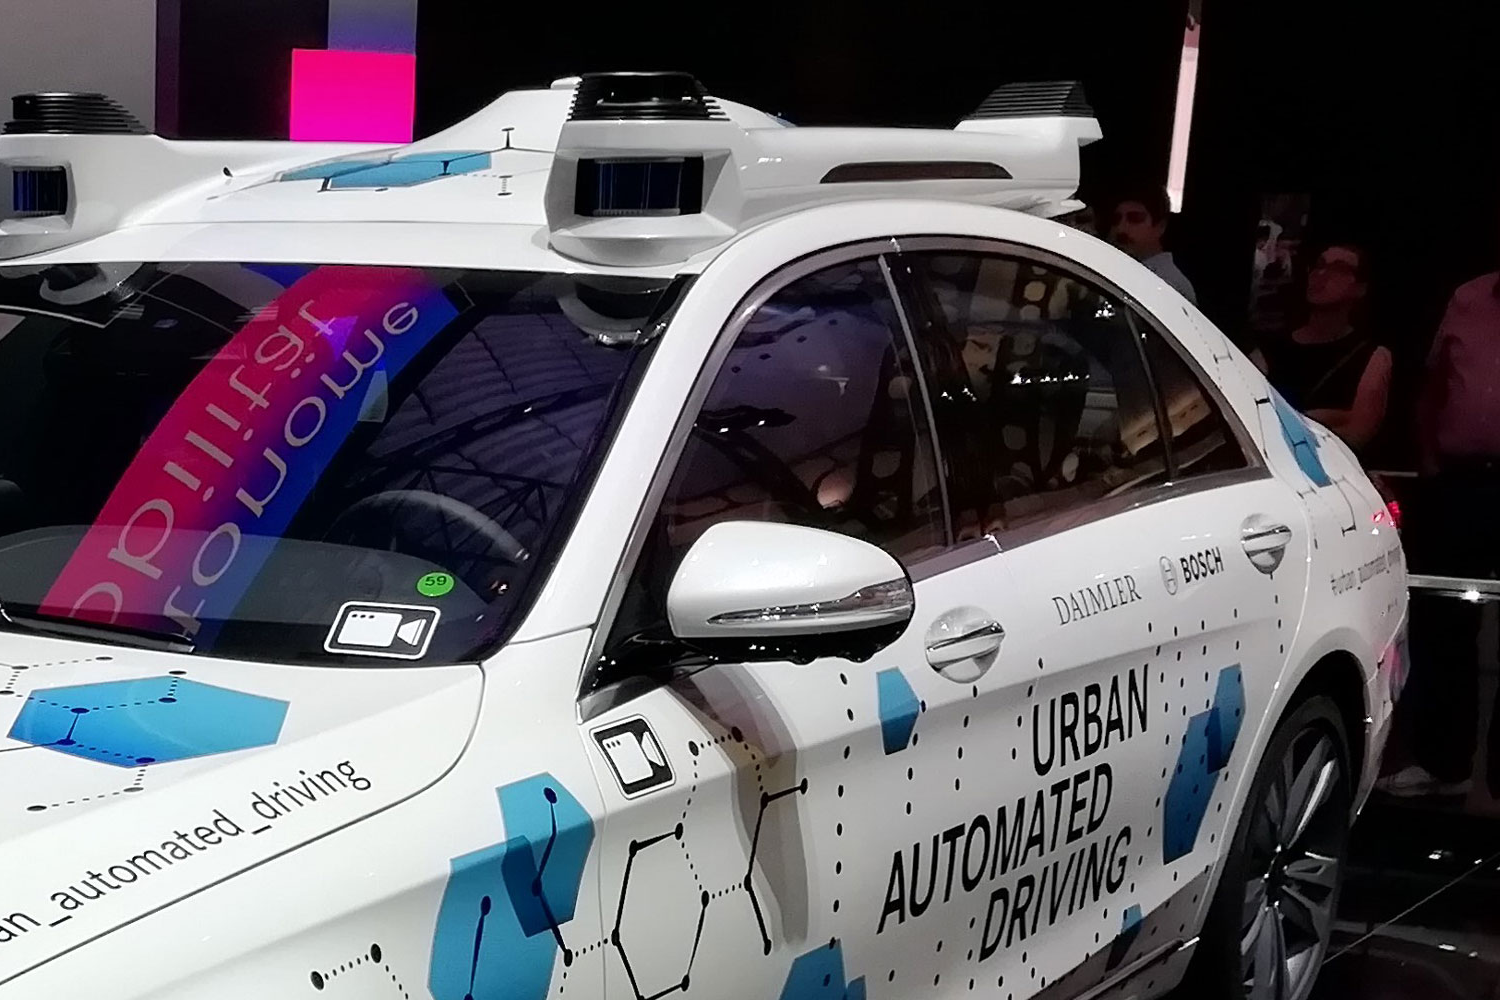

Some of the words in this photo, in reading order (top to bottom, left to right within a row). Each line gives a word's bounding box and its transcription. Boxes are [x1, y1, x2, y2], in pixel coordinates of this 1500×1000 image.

[424, 575, 448, 587] 59
[1052, 574, 1143, 626] DAIMLER
[1179, 546, 1225, 584] BOSCH
[1032, 663, 1150, 777] URBAN
[876, 762, 1113, 936] AUTOMATED
[978, 825, 1132, 964] DRIVING
